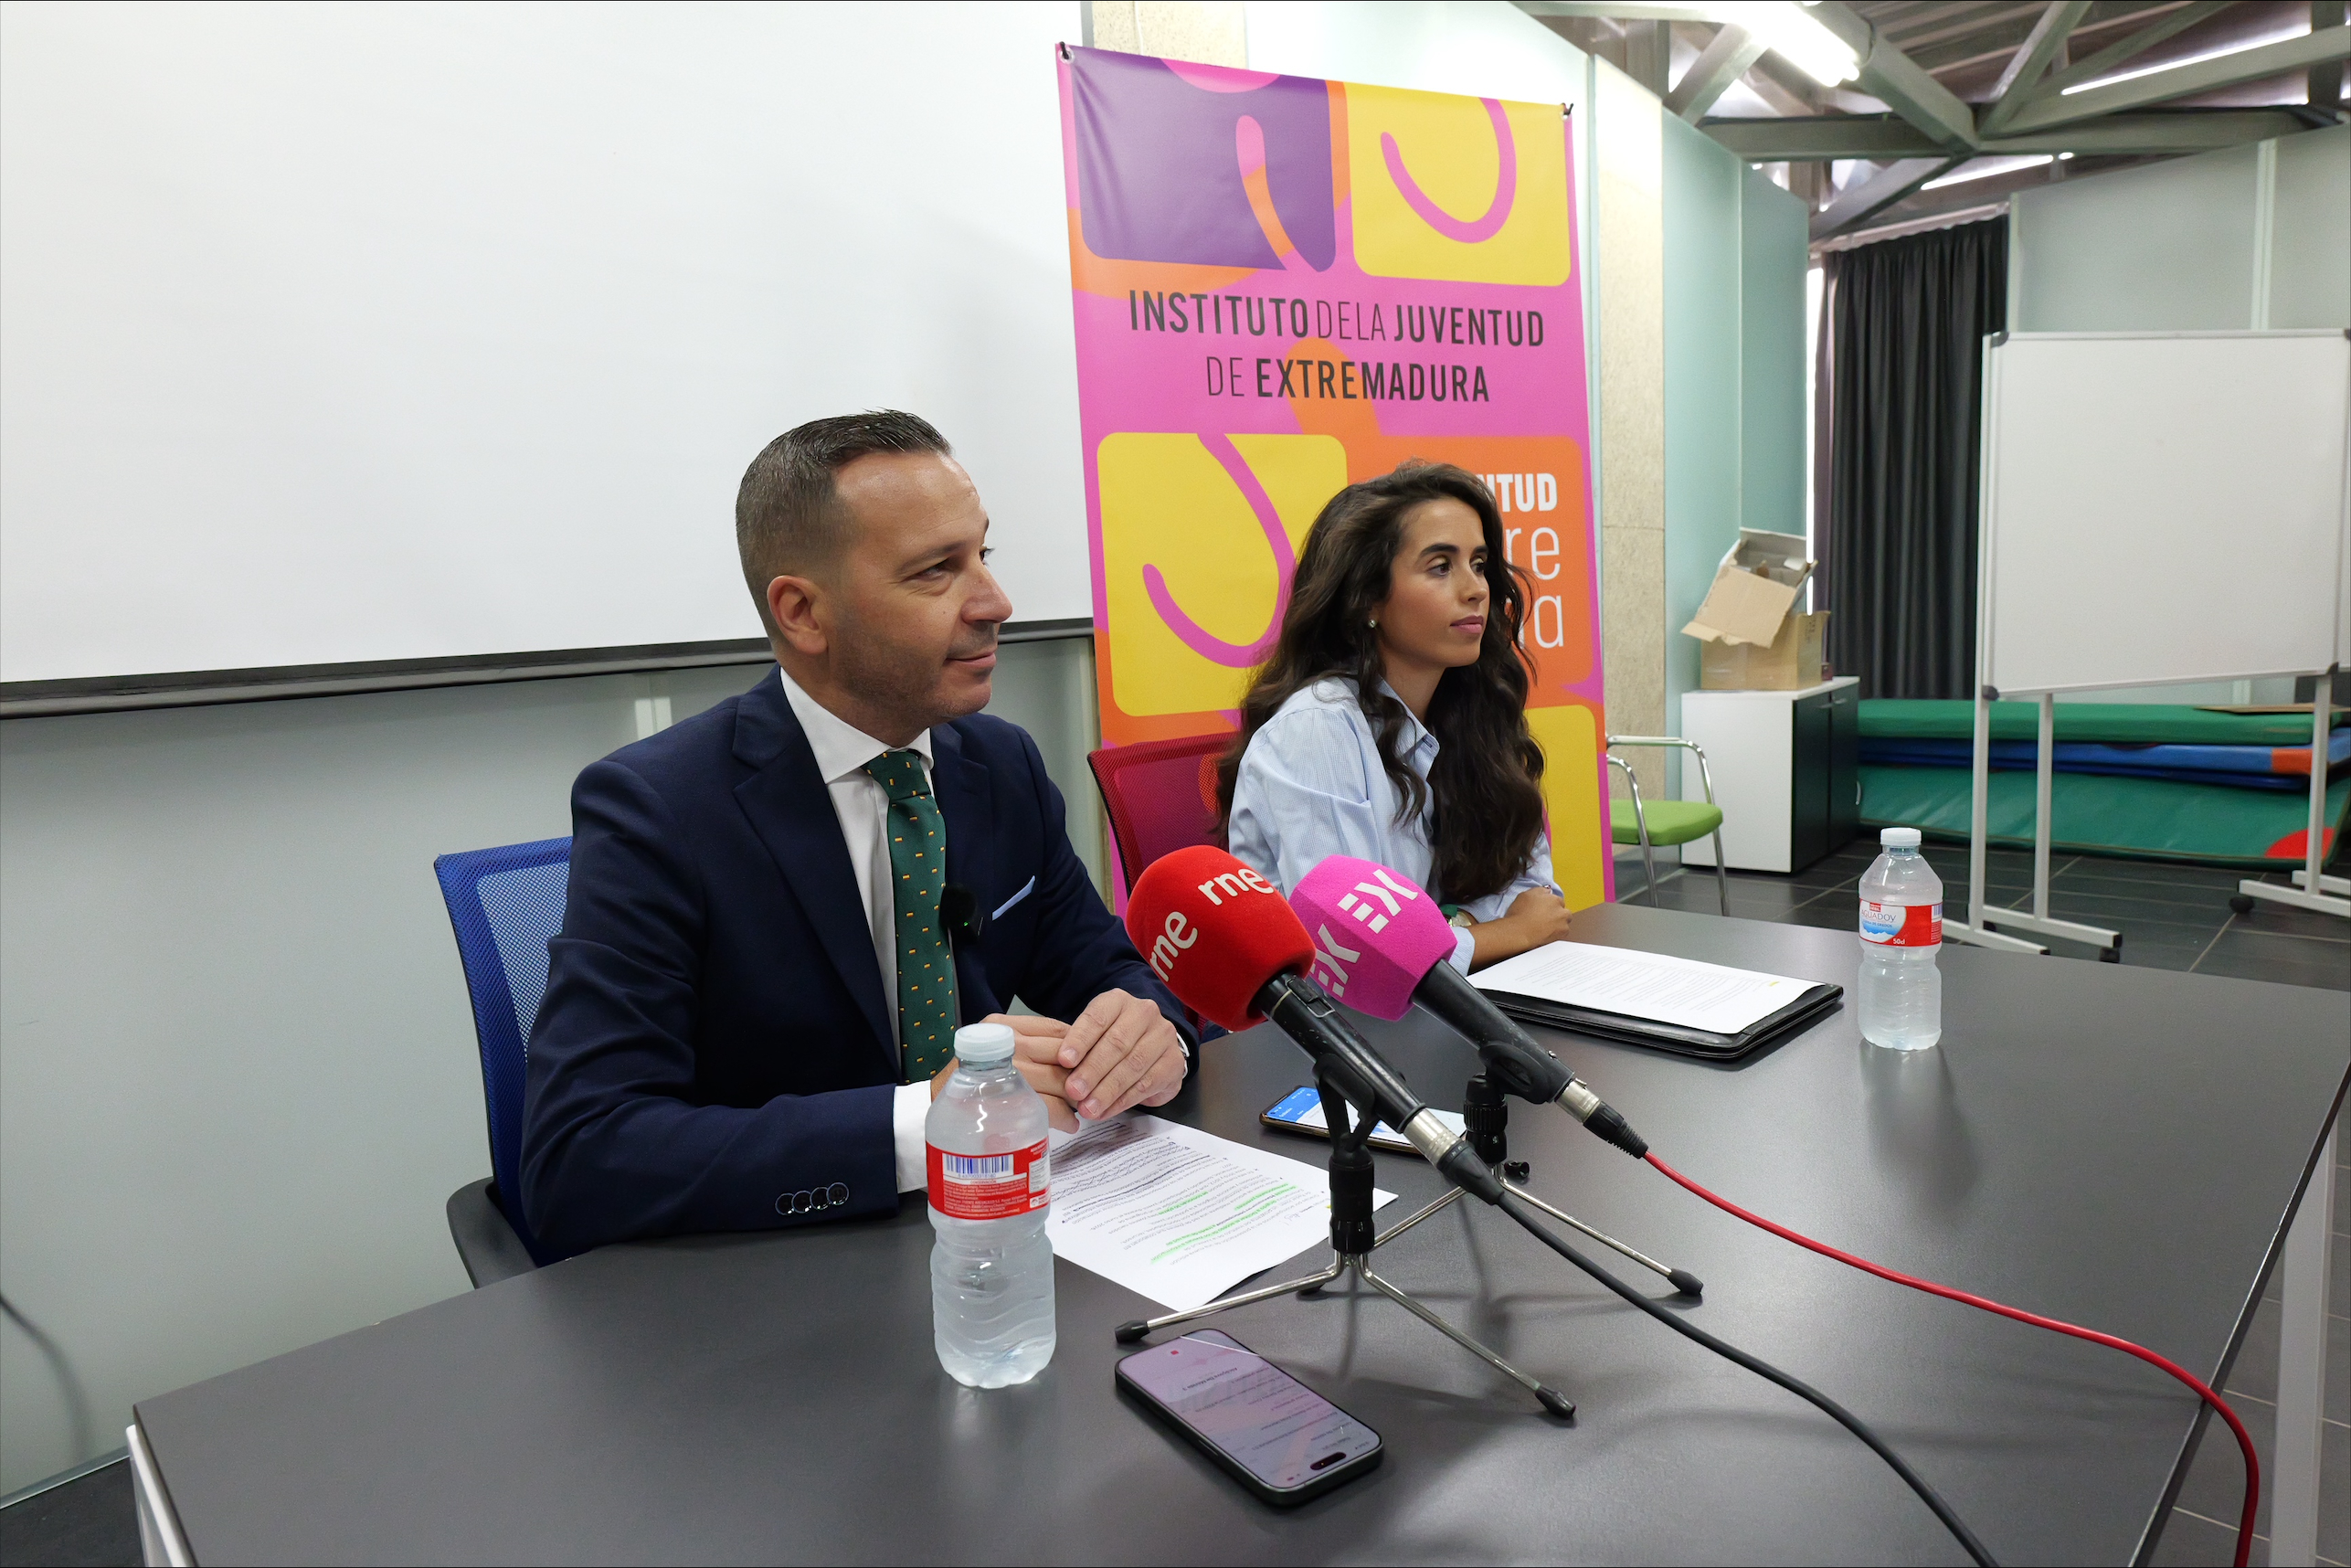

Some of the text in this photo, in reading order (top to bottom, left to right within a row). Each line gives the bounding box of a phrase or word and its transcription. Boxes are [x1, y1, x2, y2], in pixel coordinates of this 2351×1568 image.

[1129, 290, 1309, 338] INSTITUTO
[1393, 304, 1545, 347] JUVENTUD
[1206, 356, 1490, 402] DE EXTREMADURA
[1197, 868, 1275, 906] rne
[1149, 911, 1199, 982] rne
